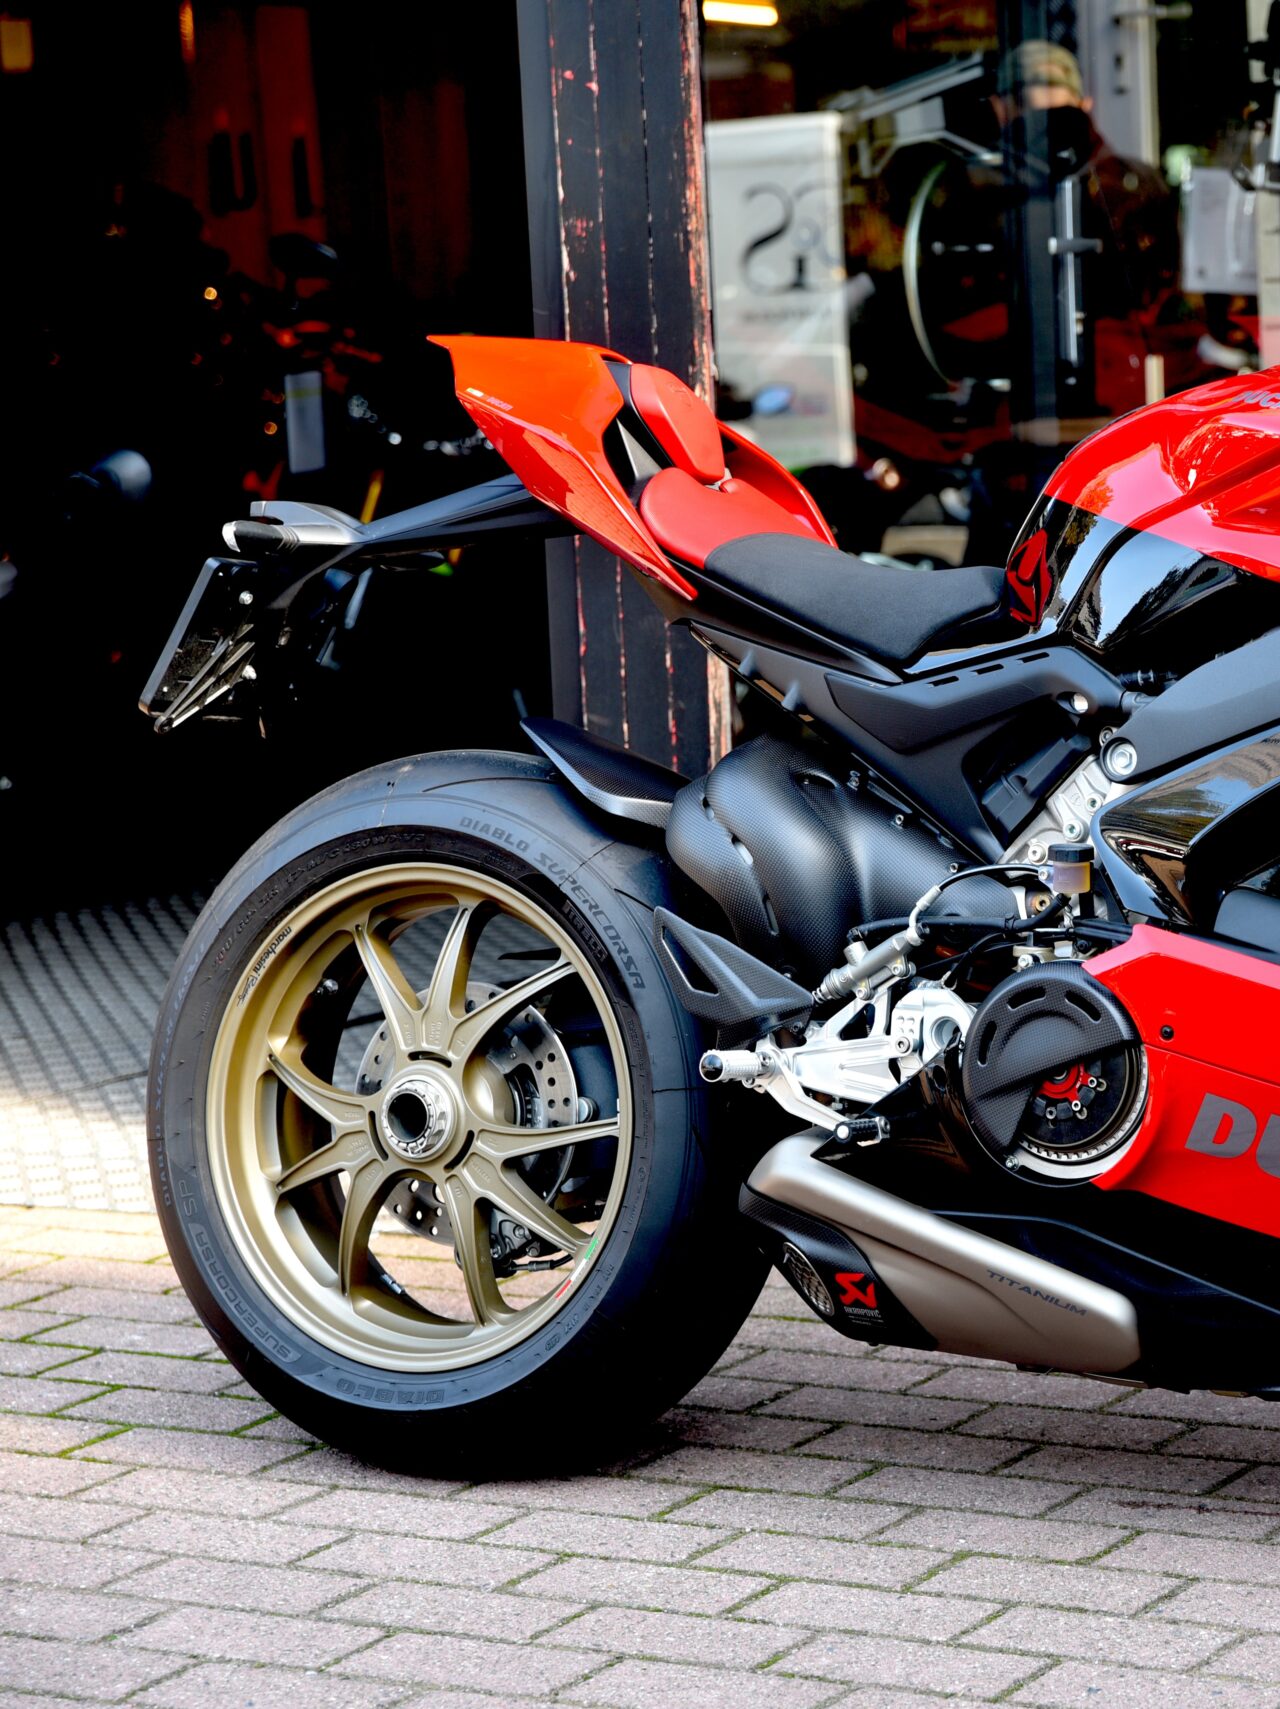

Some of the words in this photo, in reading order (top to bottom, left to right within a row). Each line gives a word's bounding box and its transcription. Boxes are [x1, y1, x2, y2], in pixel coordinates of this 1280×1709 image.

[459, 816, 531, 853] DIABLO
[533, 852, 646, 990] SUPERCORSA
[252, 925, 292, 977] marchesini
[178, 1178, 199, 1218] SP
[194, 1229, 293, 1360] SUPERCORSA
[987, 1268, 1088, 1316] TITANIUM
[335, 1377, 446, 1404] DIABLO
